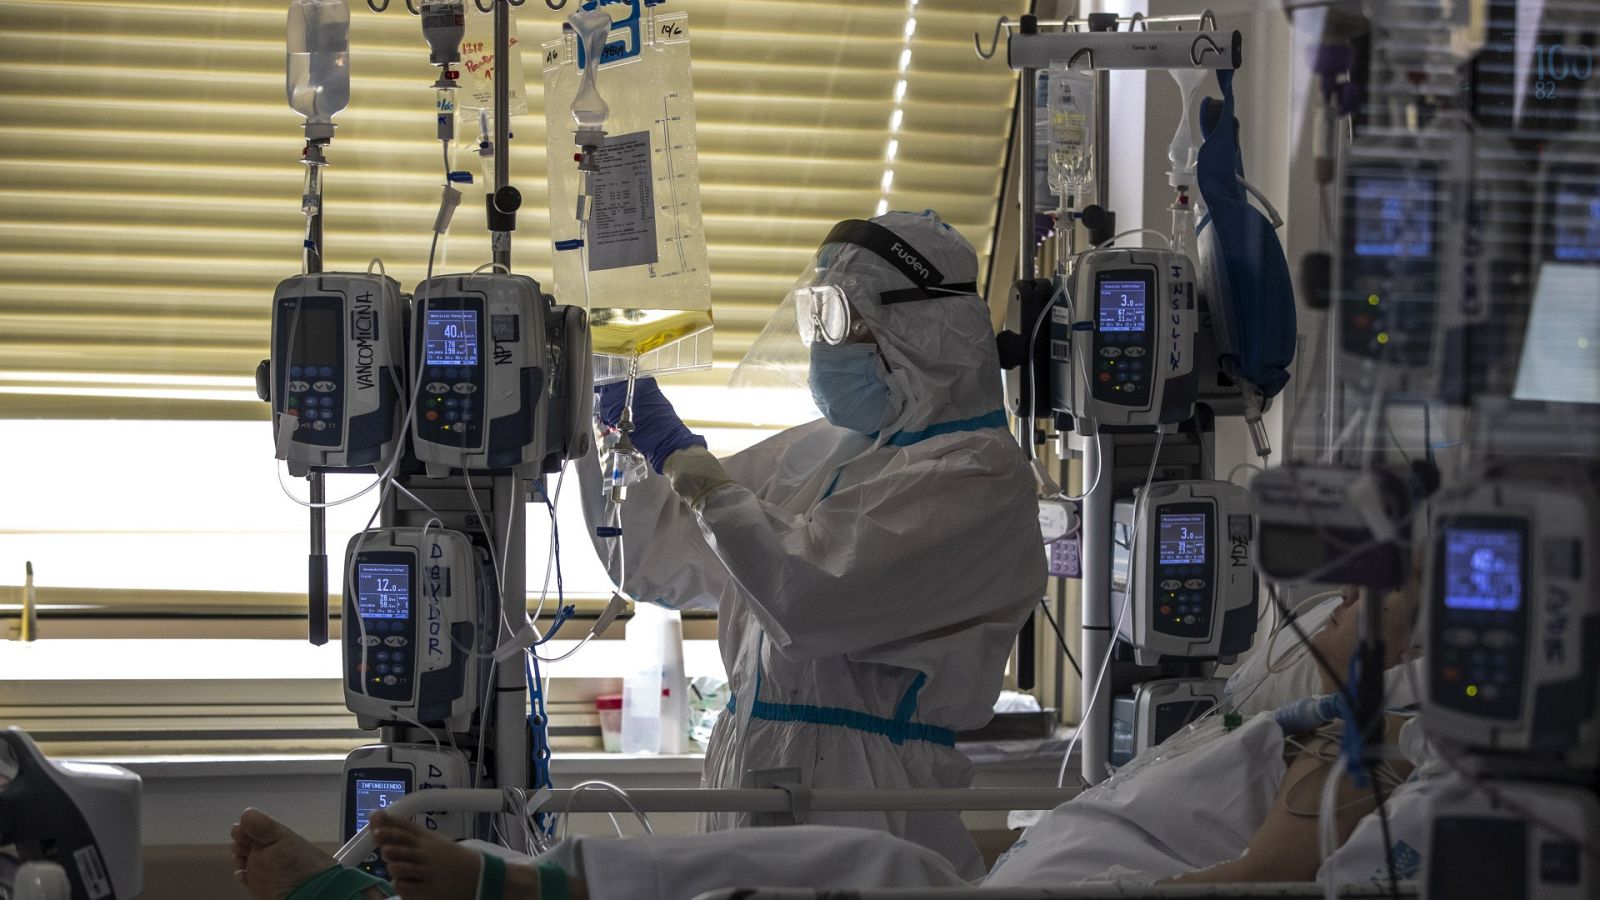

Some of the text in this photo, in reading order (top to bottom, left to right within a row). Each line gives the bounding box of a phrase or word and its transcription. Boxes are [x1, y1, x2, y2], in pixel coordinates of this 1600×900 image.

[1536, 43, 1593, 80] 100
[1535, 81, 1556, 99] 82
[890, 242, 930, 279] Fuden
[1121, 294, 1134, 307] 3.0
[354, 291, 375, 390] VANCOMICINA
[493, 336, 515, 366] NPT
[1181, 527, 1194, 540] 3.0
[1230, 535, 1249, 567] MDZ
[377, 578, 397, 592] 12.0
[361, 782, 402, 790] INFUNDIENDO
